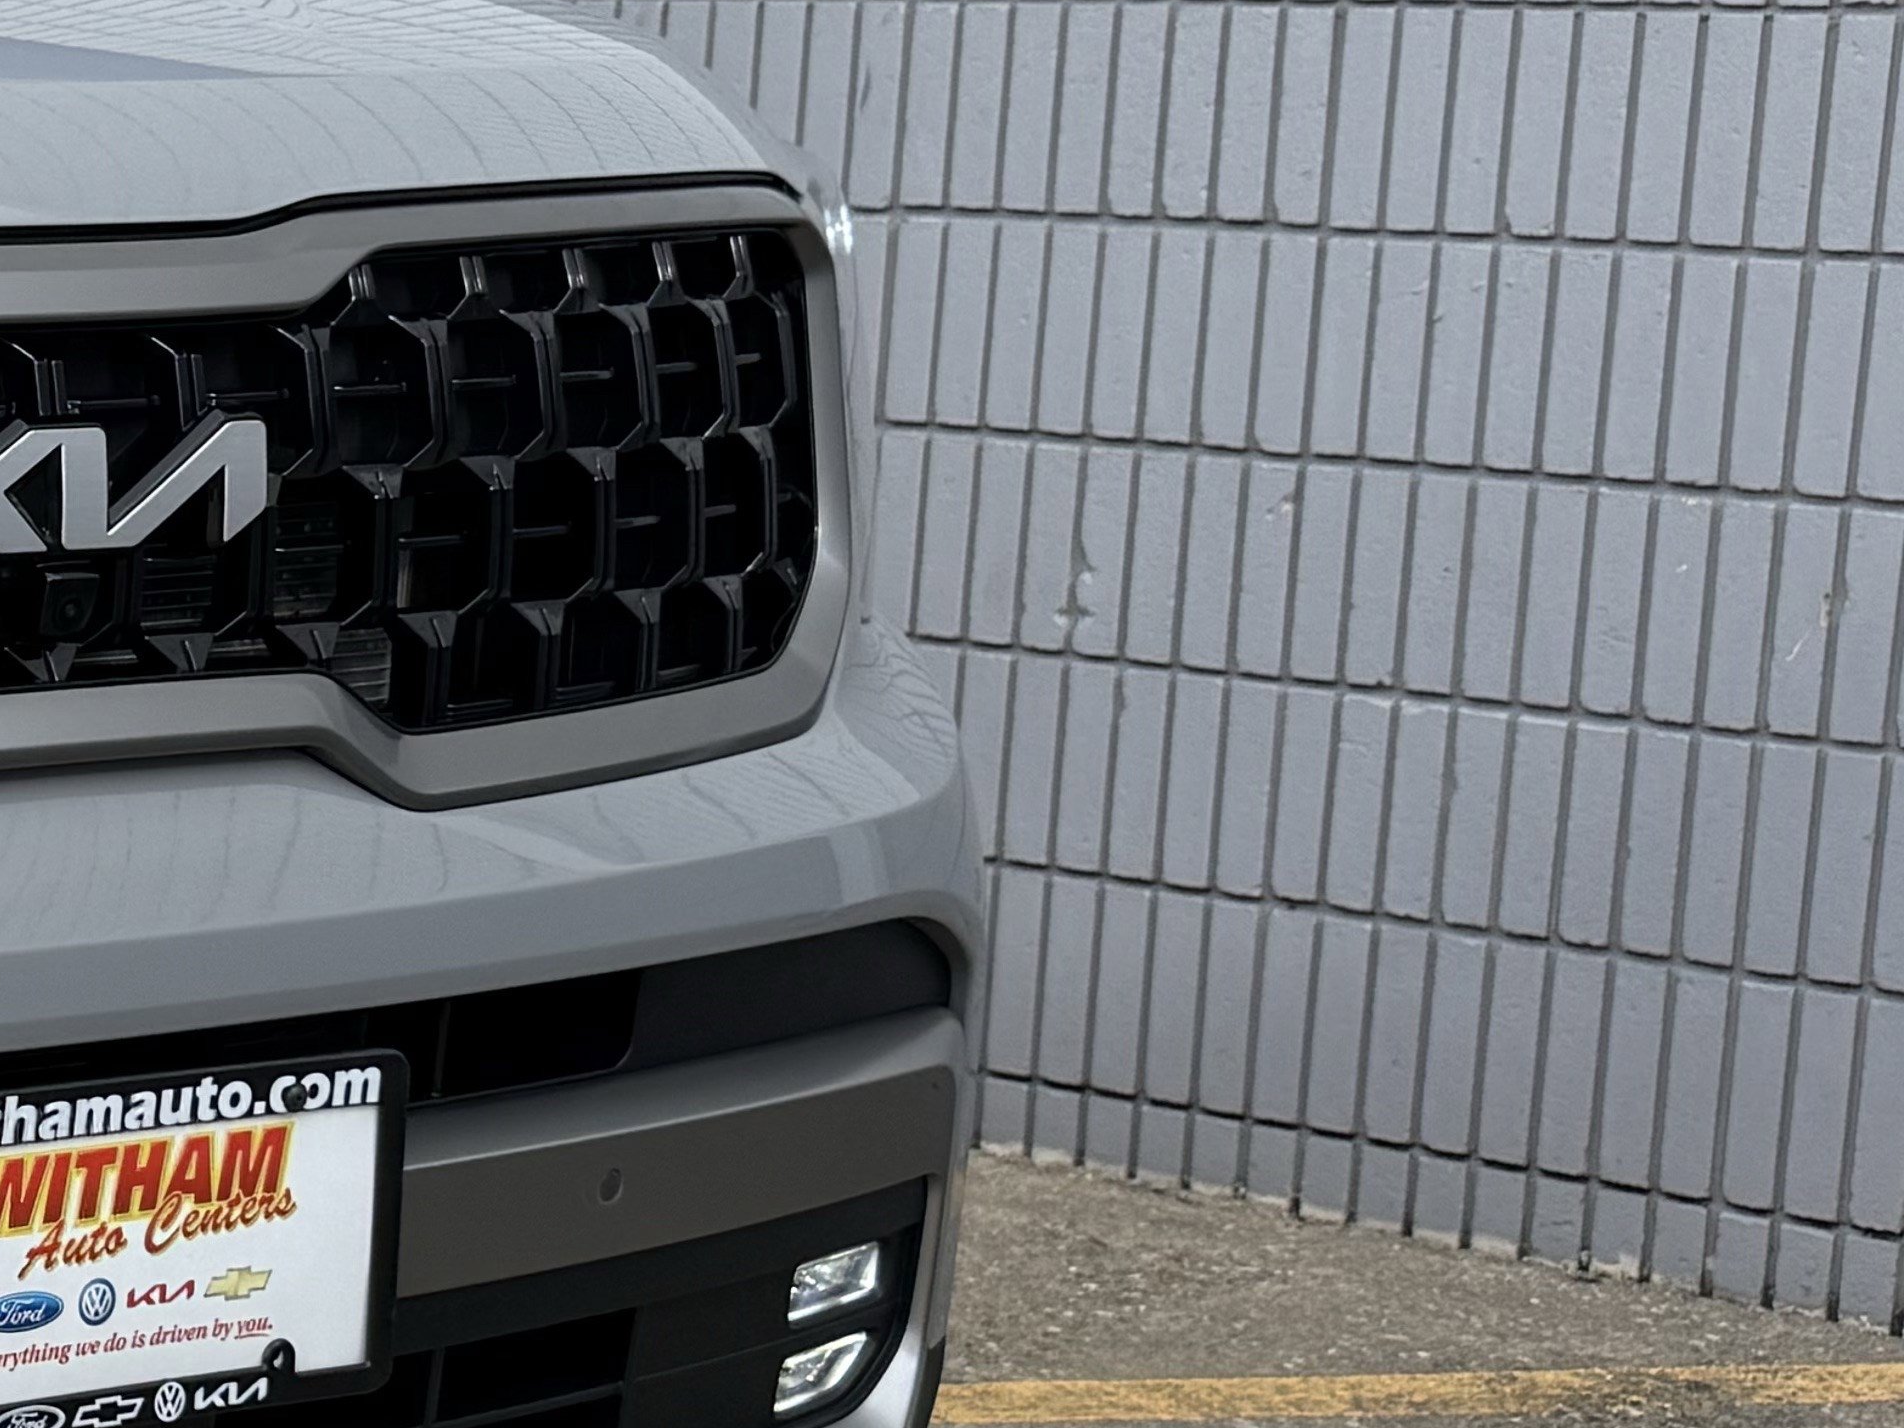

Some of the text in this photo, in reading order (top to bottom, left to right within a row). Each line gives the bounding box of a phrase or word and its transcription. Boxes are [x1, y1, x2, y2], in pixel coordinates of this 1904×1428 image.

[18, 1187, 296, 1280] Auto Centers
[126, 1278, 195, 1309] KIA
[75, 1339, 101, 1356] we
[103, 1335, 127, 1353] do
[130, 1331, 147, 1349] is
[149, 1324, 208, 1347] driven
[211, 1319, 234, 1341] by
[194, 1376, 269, 1411] KIA
